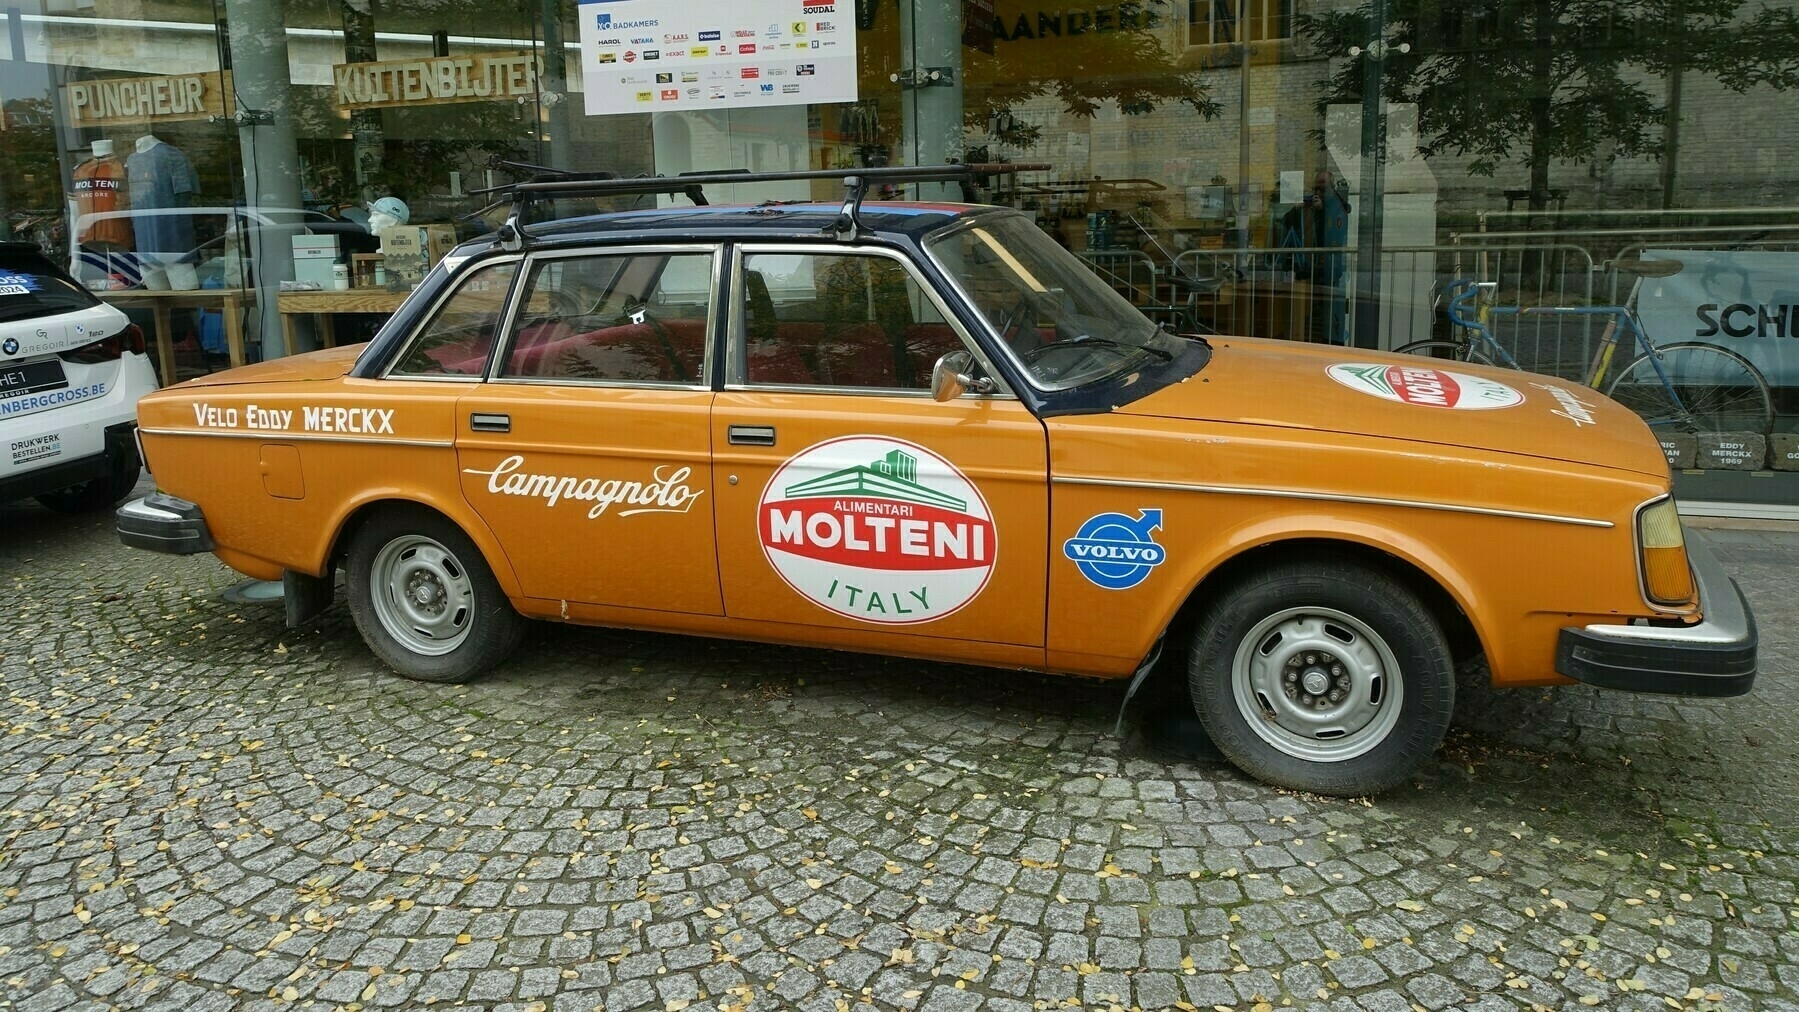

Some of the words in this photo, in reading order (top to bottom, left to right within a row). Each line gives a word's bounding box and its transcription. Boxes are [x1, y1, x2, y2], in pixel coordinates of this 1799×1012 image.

[803, 6, 835, 15] SOUDAL
[613, 20, 659, 29] BADKAMERS
[336, 55, 545, 104] KUITENBIJTER
[71, 77, 206, 120] PUNCHEUR
[1696, 303, 1799, 338] SCH
[22, 341, 65, 354] GREGOIR
[0, 389, 30, 399] REGOIR
[0, 383, 105, 415] NBERGCROSS.BE
[302, 406, 395, 434] MERCKX
[11, 434, 60, 450] DRUKWERK
[12, 443, 61, 459] BESTELLEN.BE
[1712, 450, 1752, 458] MERCKX
[463, 455, 704, 519] Campagnolo
[833, 499, 914, 517] ALIMENTARI
[769, 508, 986, 562] MOLTENI
[1071, 543, 1160, 562] VOLVO
[827, 579, 931, 615] ITALY
